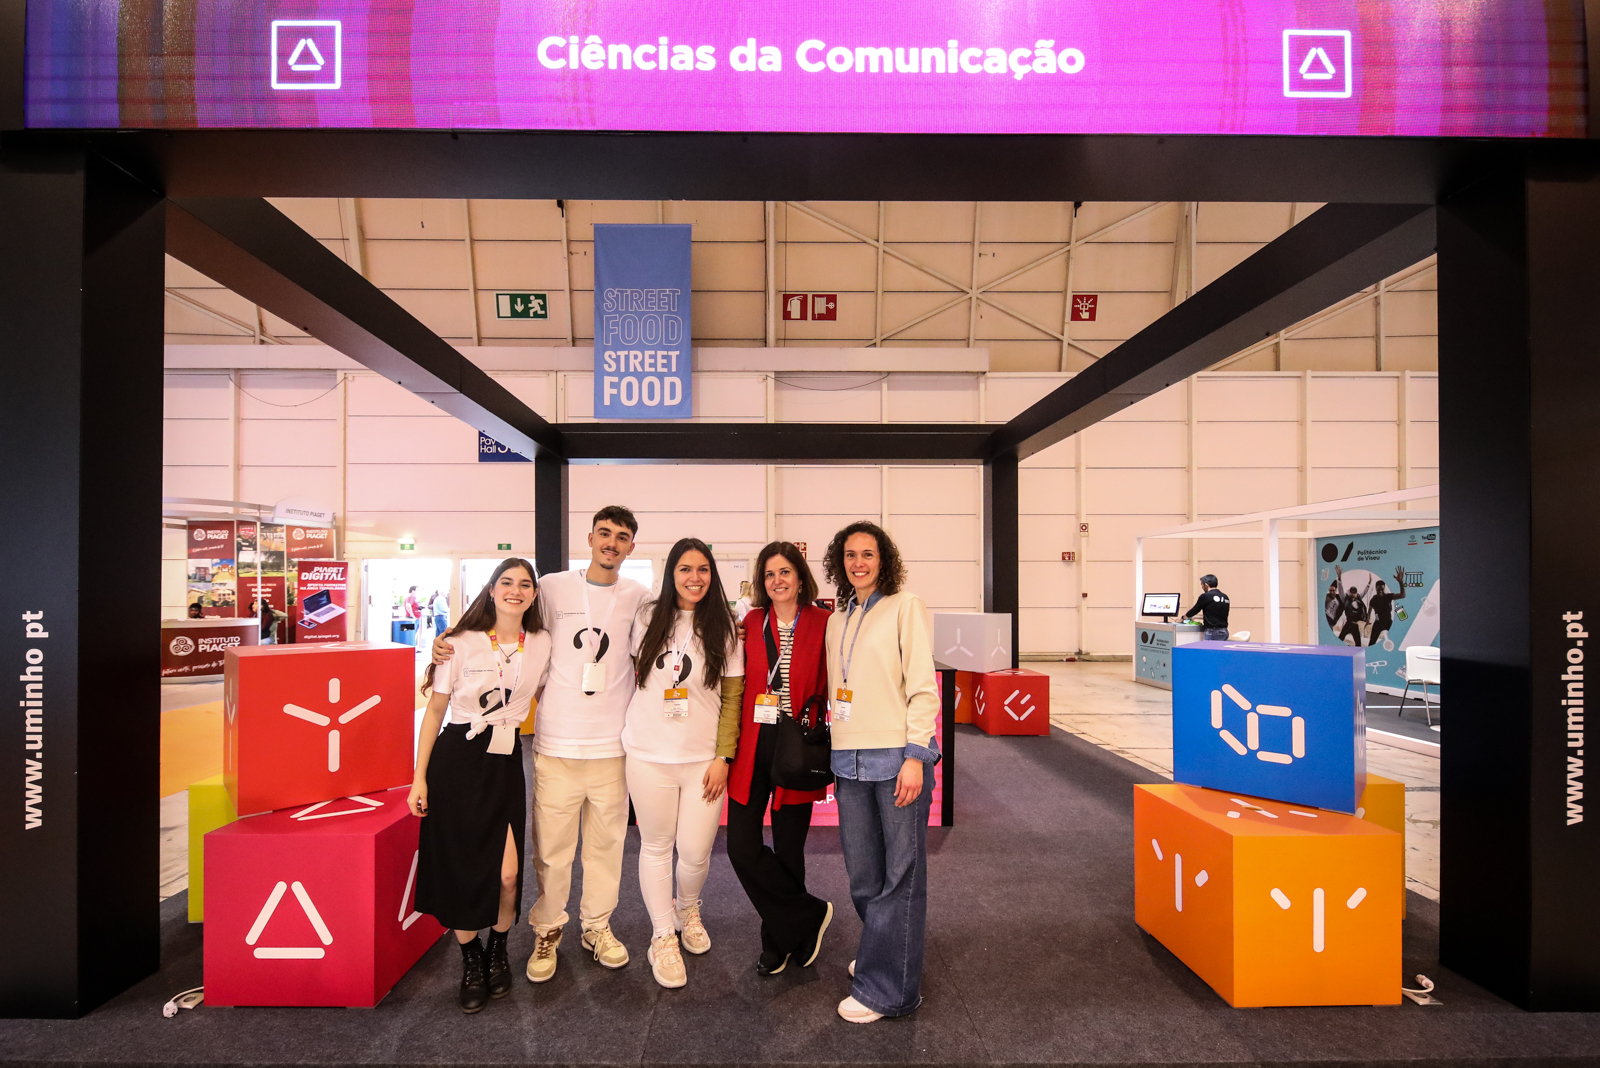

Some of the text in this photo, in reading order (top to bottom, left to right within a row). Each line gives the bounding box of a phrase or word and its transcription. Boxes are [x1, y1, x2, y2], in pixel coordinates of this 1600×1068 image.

[537, 34, 1086, 81] Ciências da Comunicação
[603, 288, 681, 312] STREET
[603, 313, 683, 346] FOOD
[603, 350, 680, 373] STREET
[603, 376, 683, 407] FOOD
[480, 436, 496, 446] Pav
[480, 445, 497, 453] Hall
[285, 508, 309, 517] INSTITUTO
[1357, 548, 1387, 556] Politécnico
[198, 636, 241, 645] INSTITUTO
[19, 610, 50, 831] www.uminho pt
[1560, 610, 1589, 827] www.uminho.pt
